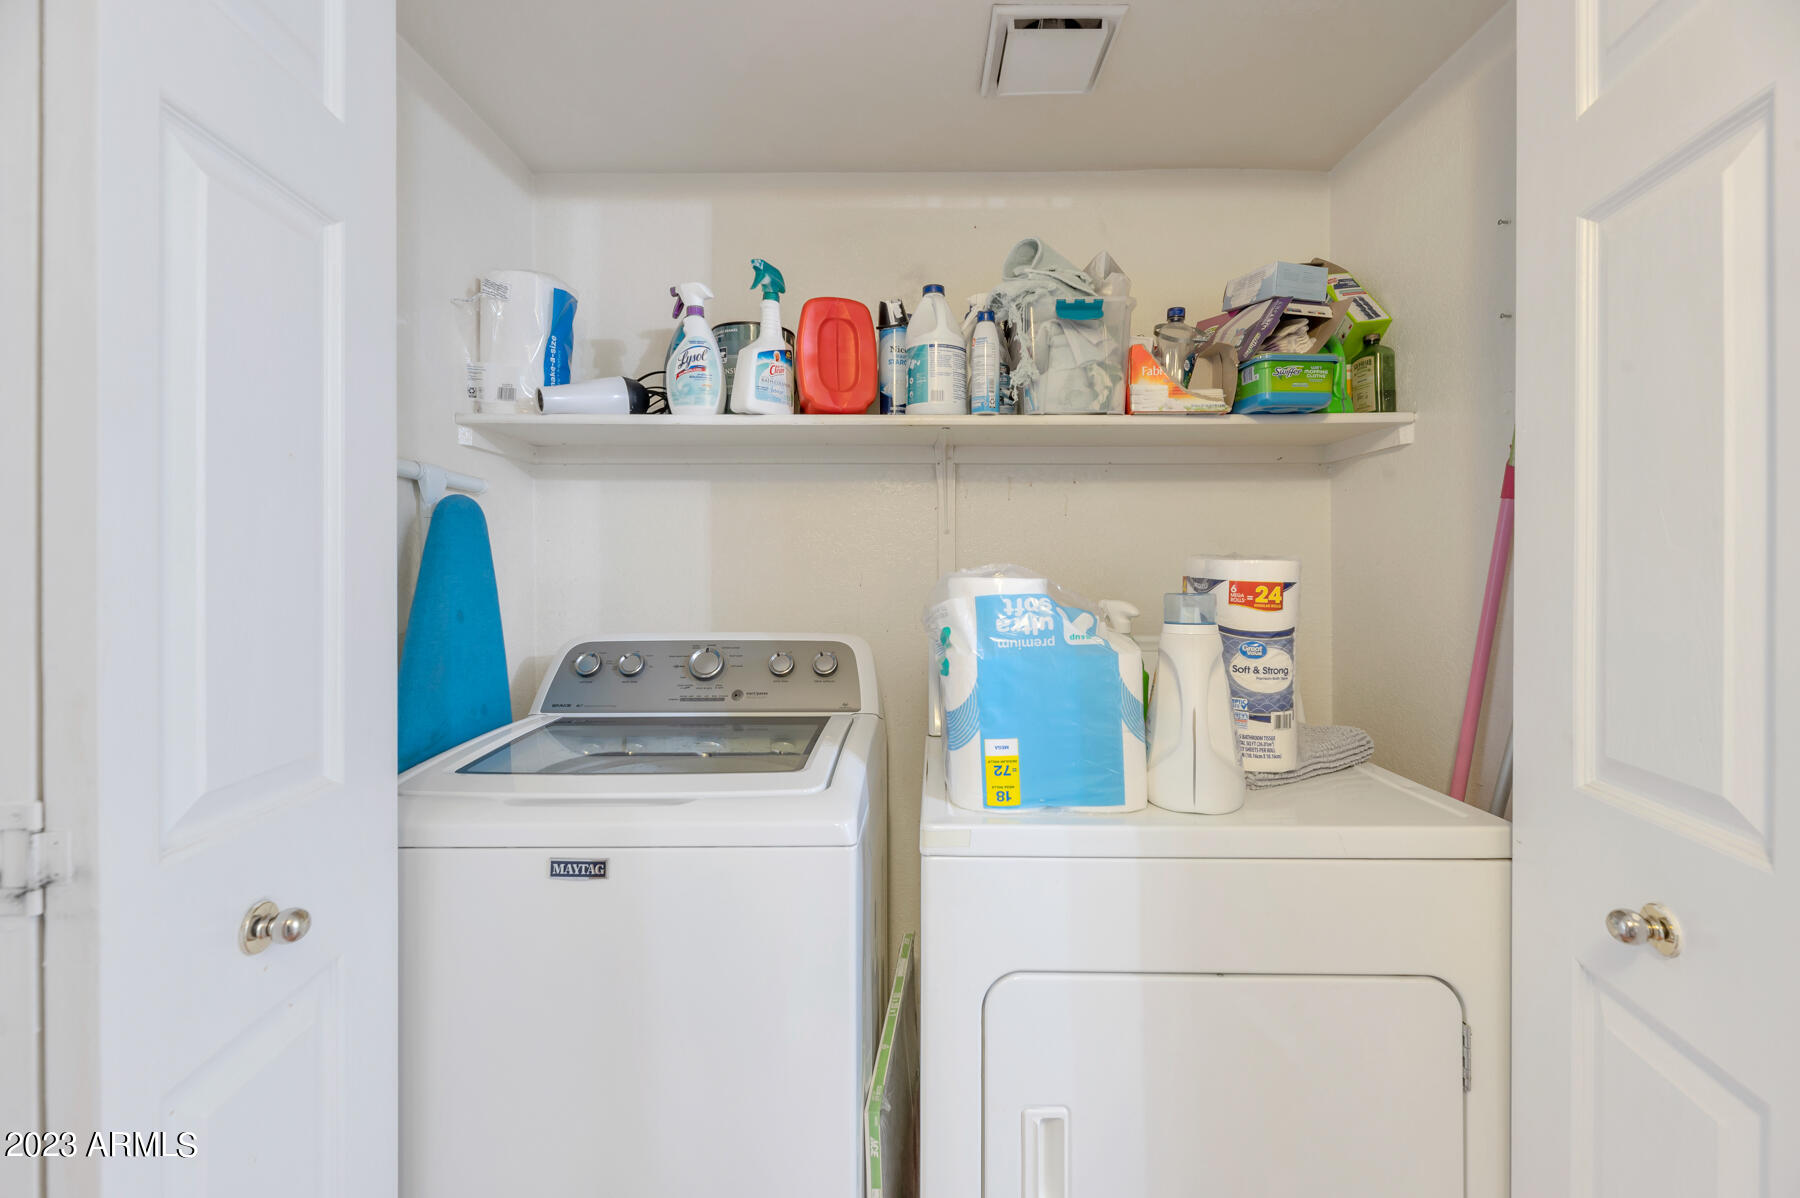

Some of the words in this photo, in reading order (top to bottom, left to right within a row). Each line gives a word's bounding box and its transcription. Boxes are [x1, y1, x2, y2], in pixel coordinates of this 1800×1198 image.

[678, 349, 708, 369] Lysol
[1272, 366, 1303, 378] Swiffer
[1230, 584, 1238, 593] 6
[1255, 585, 1282, 604] 24
[1002, 597, 1053, 616] soft
[996, 613, 1054, 636] ultra
[997, 636, 1056, 650] premium
[1232, 664, 1251, 674] Soft
[1253, 666, 1260, 674] &
[1262, 667, 1289, 677] Strong
[993, 764, 1012, 777] 72
[995, 791, 1012, 803] 18
[552, 863, 605, 875] MAYTAG
